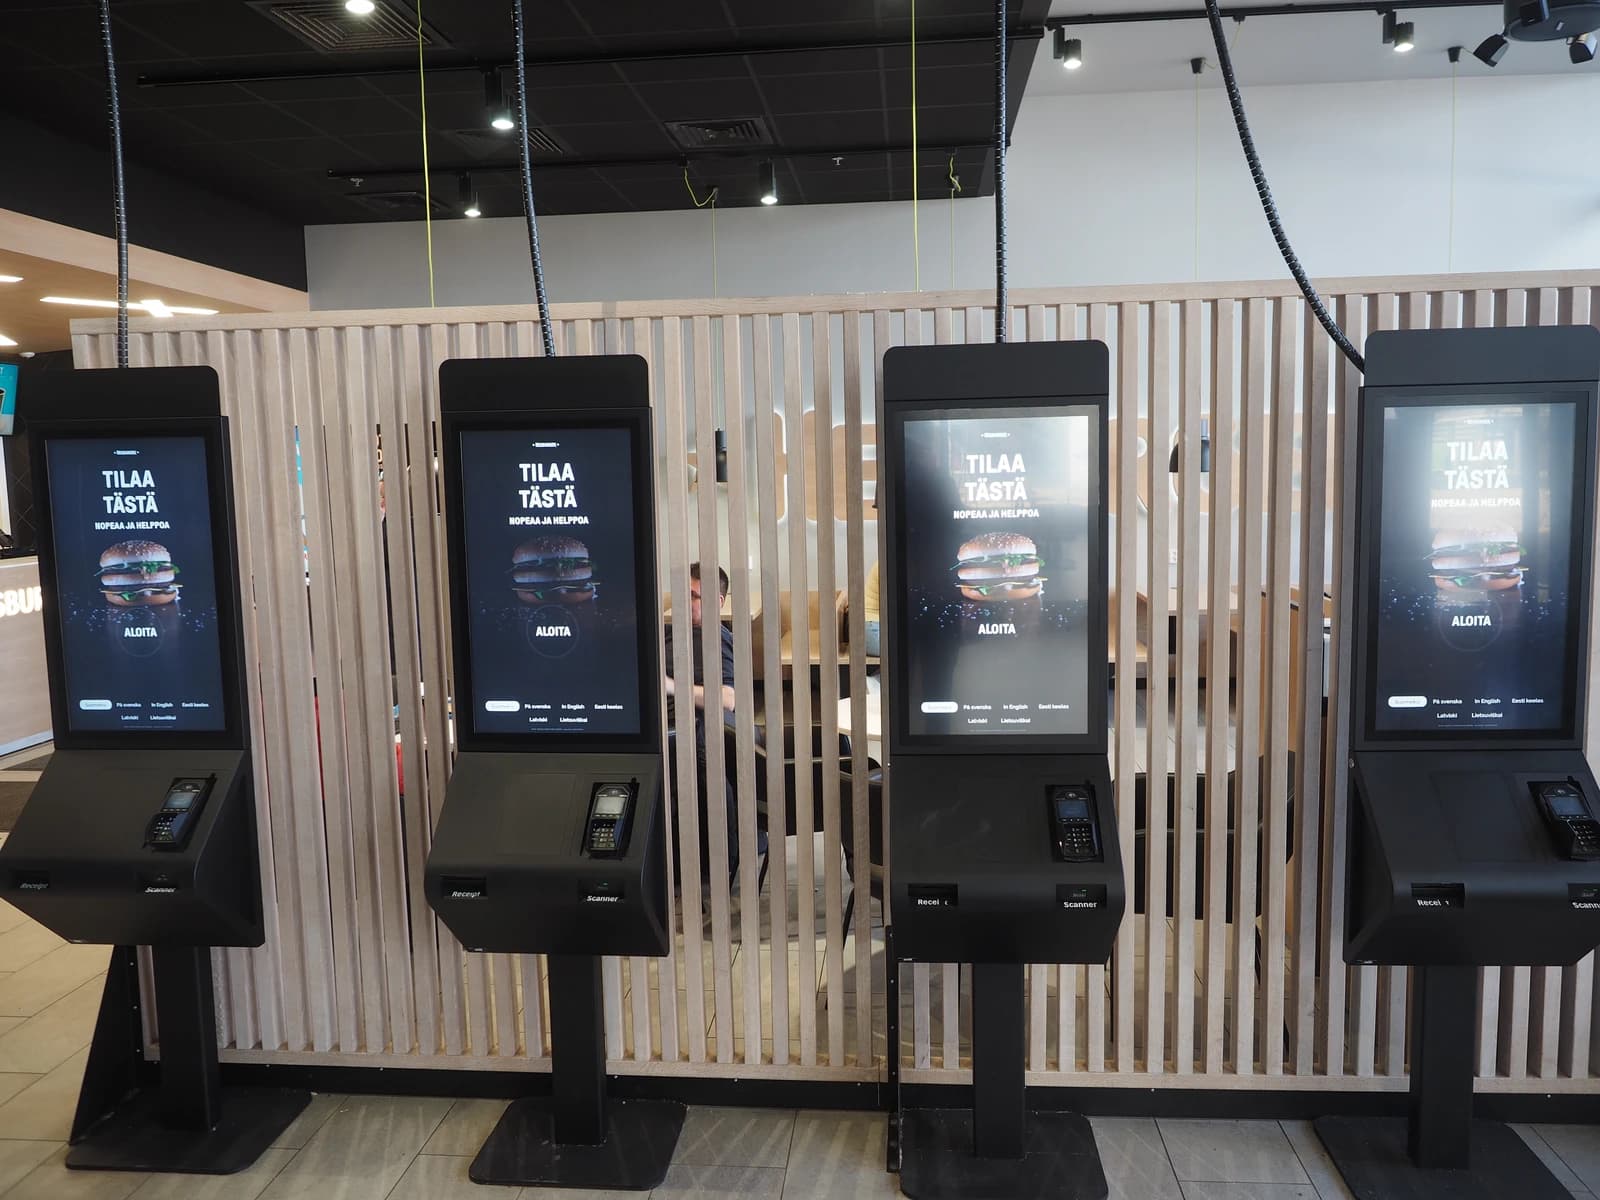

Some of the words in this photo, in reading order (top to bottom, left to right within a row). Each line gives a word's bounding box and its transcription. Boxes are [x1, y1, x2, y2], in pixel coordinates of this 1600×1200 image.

[1446, 441, 1509, 462] TILAA
[966, 453, 1026, 474] TILAA
[102, 470, 155, 488] TILAA
[519, 463, 575, 482] TILAA
[1444, 465, 1509, 489] TÄSTÄ
[518, 485, 577, 508] TÄSTÄ
[964, 477, 1027, 501] TÄSTÄ
[102, 492, 158, 514] TÄSTÄ
[509, 516, 540, 525] NOPEAA
[541, 516, 552, 525] JA
[553, 516, 589, 524] HELPPOA
[953, 510, 987, 519] NOPEAA
[989, 509, 999, 518] JA
[1001, 509, 1039, 518] HELPPOA
[95, 522, 125, 530] NOPEAA
[126, 522, 135, 530] JA
[136, 521, 170, 529] HELPPOA
[978, 623, 1016, 634] ALOITA
[1451, 615, 1491, 627] ALOITA
[124, 627, 158, 638] ALOITA
[536, 626, 571, 637] ALOITA
[586, 895, 619, 903] Scanner
